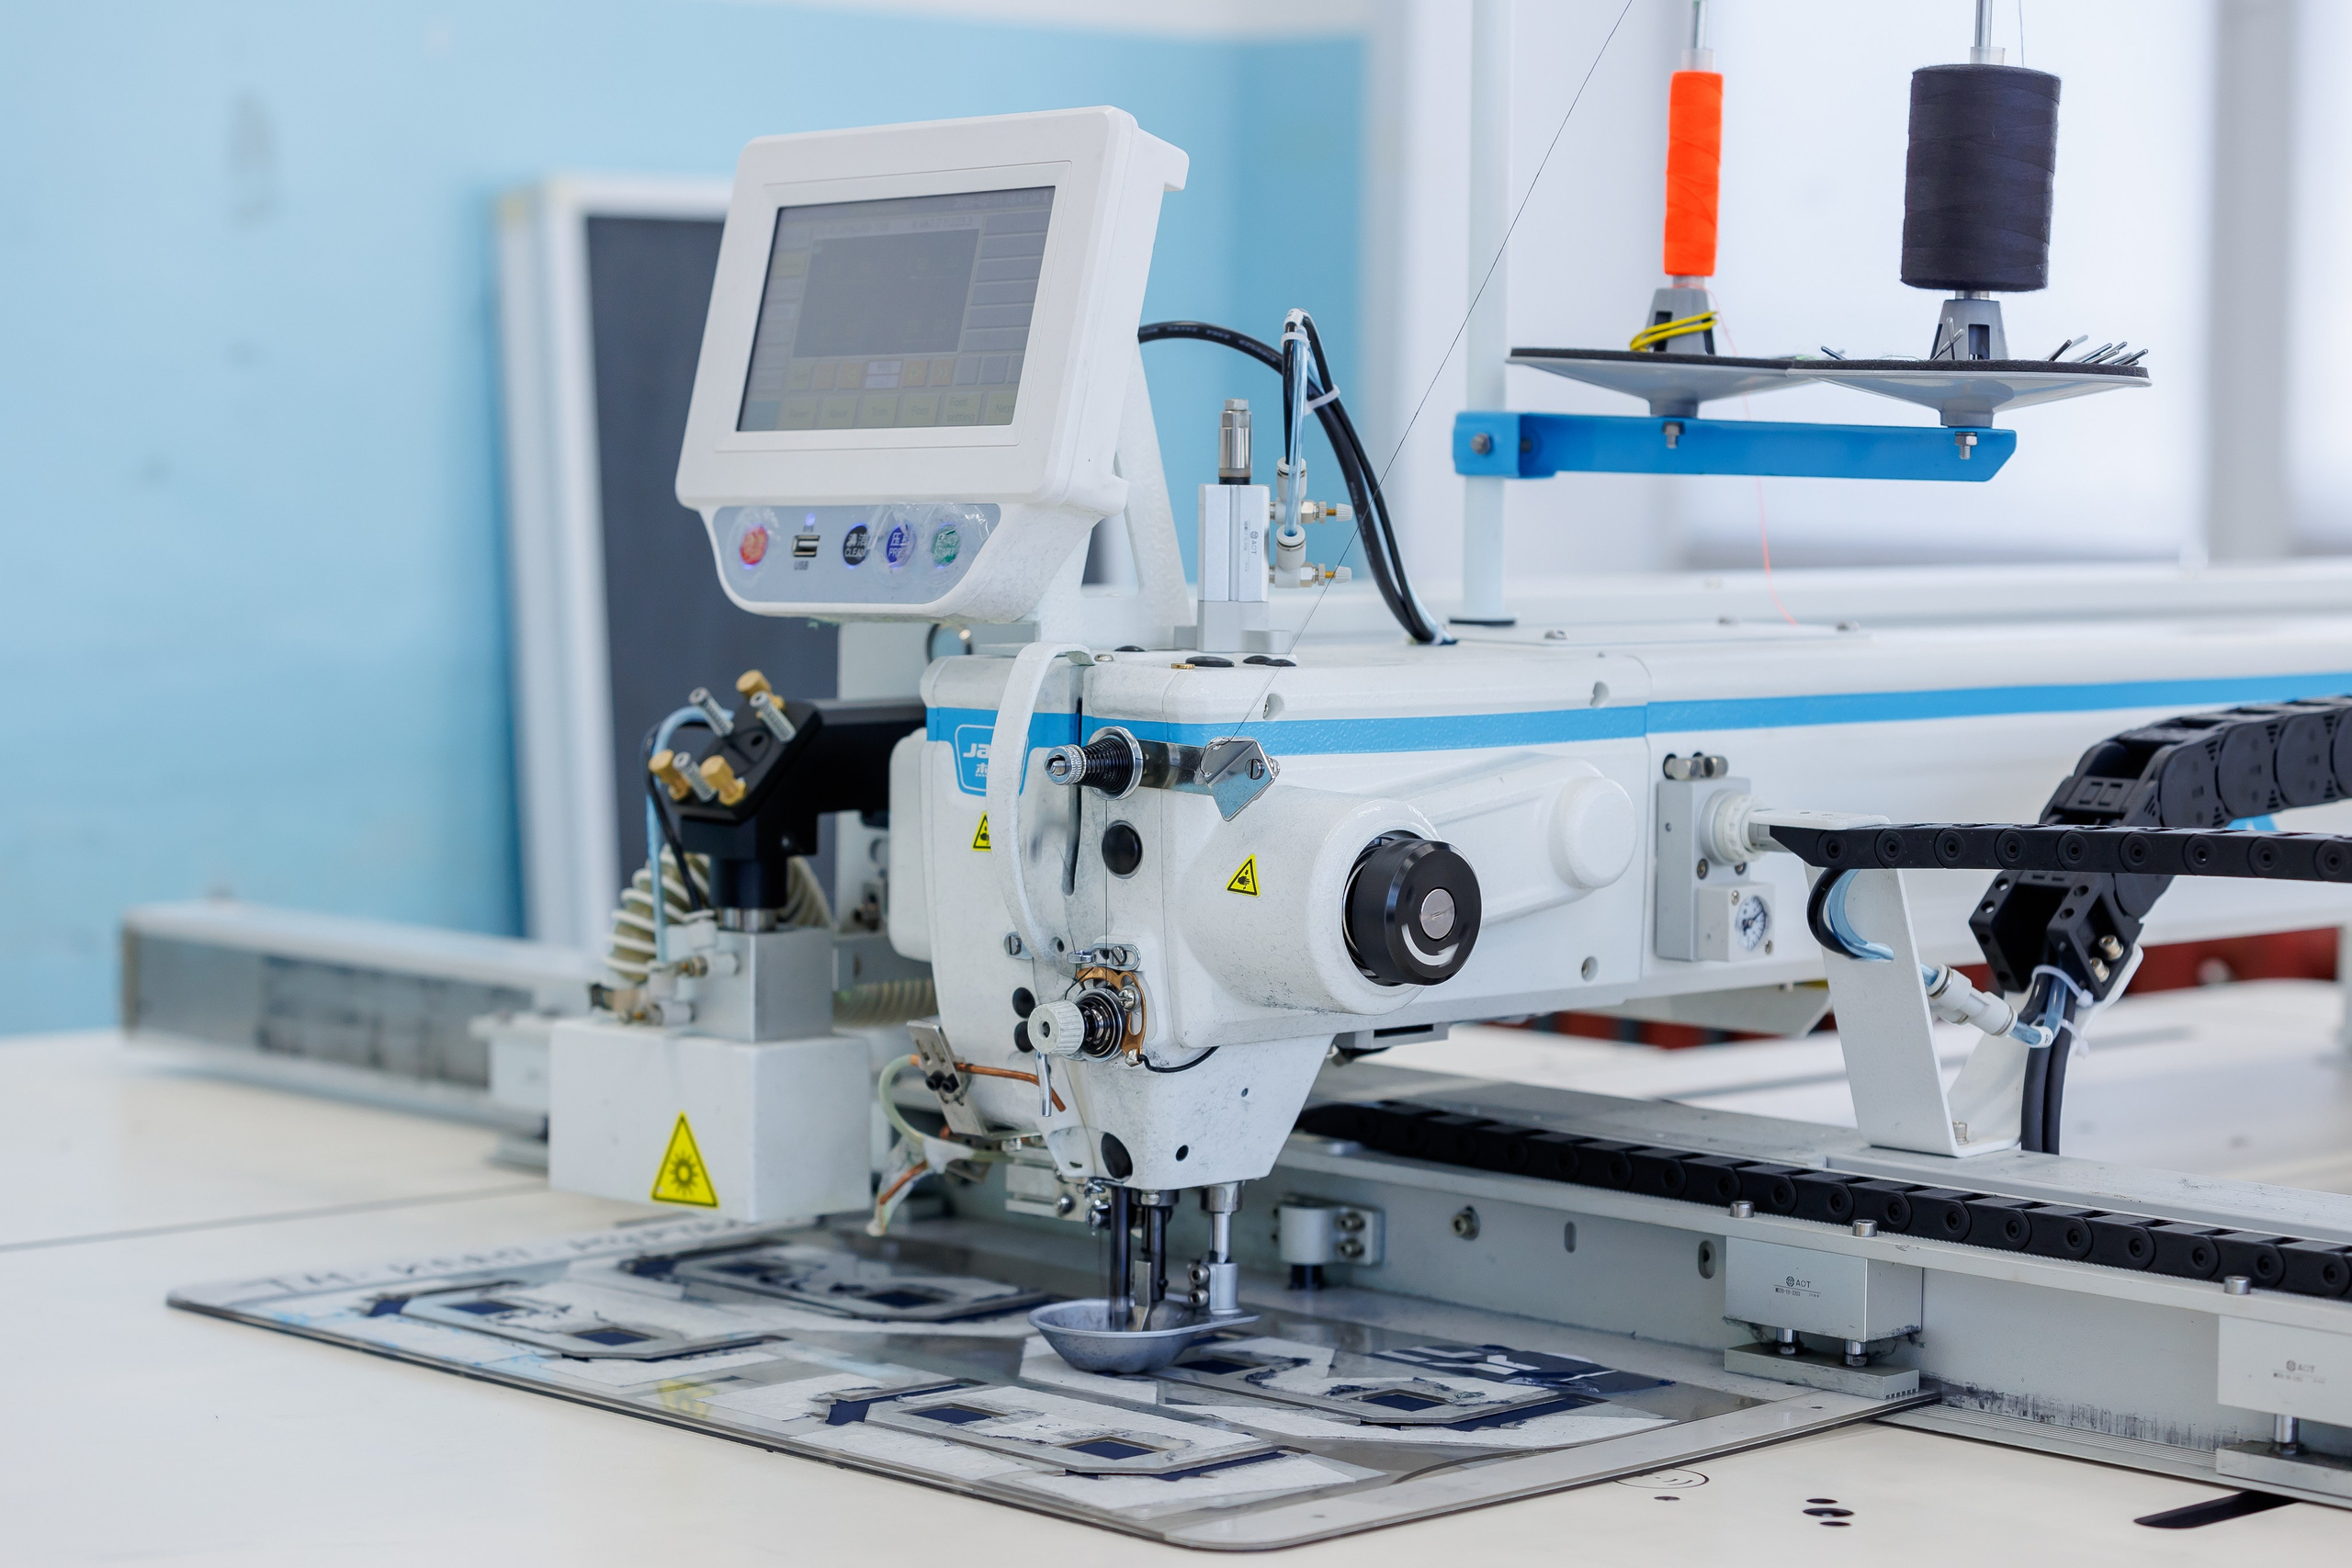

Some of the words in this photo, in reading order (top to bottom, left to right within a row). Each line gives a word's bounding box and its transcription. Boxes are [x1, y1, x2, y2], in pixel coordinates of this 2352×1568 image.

[949, 396, 968, 407] Foot
[946, 412, 976, 423] setting
[1795, 1279, 1811, 1288] AOT
